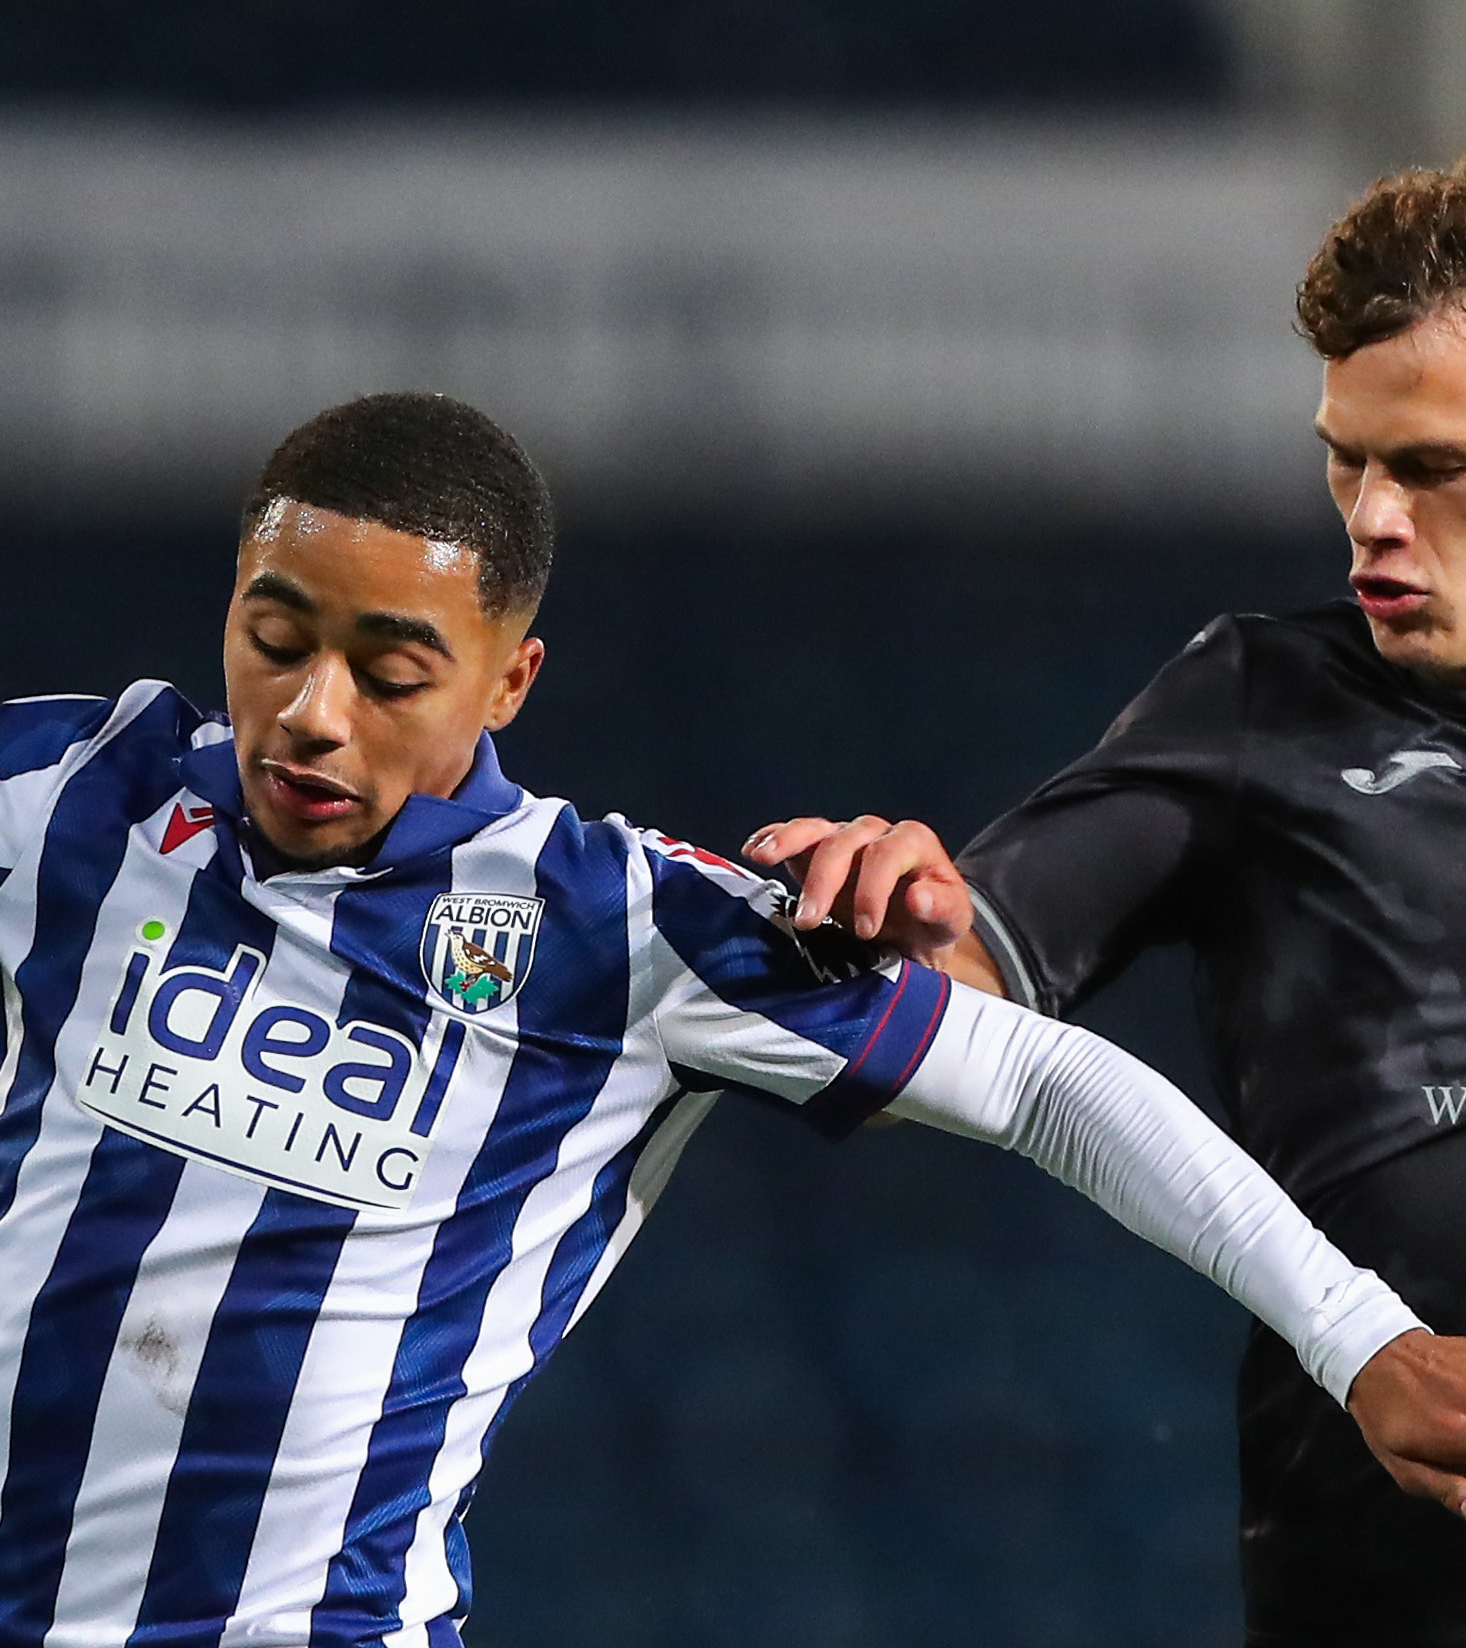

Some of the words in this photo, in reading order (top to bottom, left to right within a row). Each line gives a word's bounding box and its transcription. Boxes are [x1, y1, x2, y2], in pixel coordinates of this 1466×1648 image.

[435, 904, 532, 930] ALBION
[442, 896, 473, 905] WEST
[474, 898, 536, 911] BROMWICH
[109, 920, 467, 1139] ideal
[85, 1046, 421, 1192] HEATING
